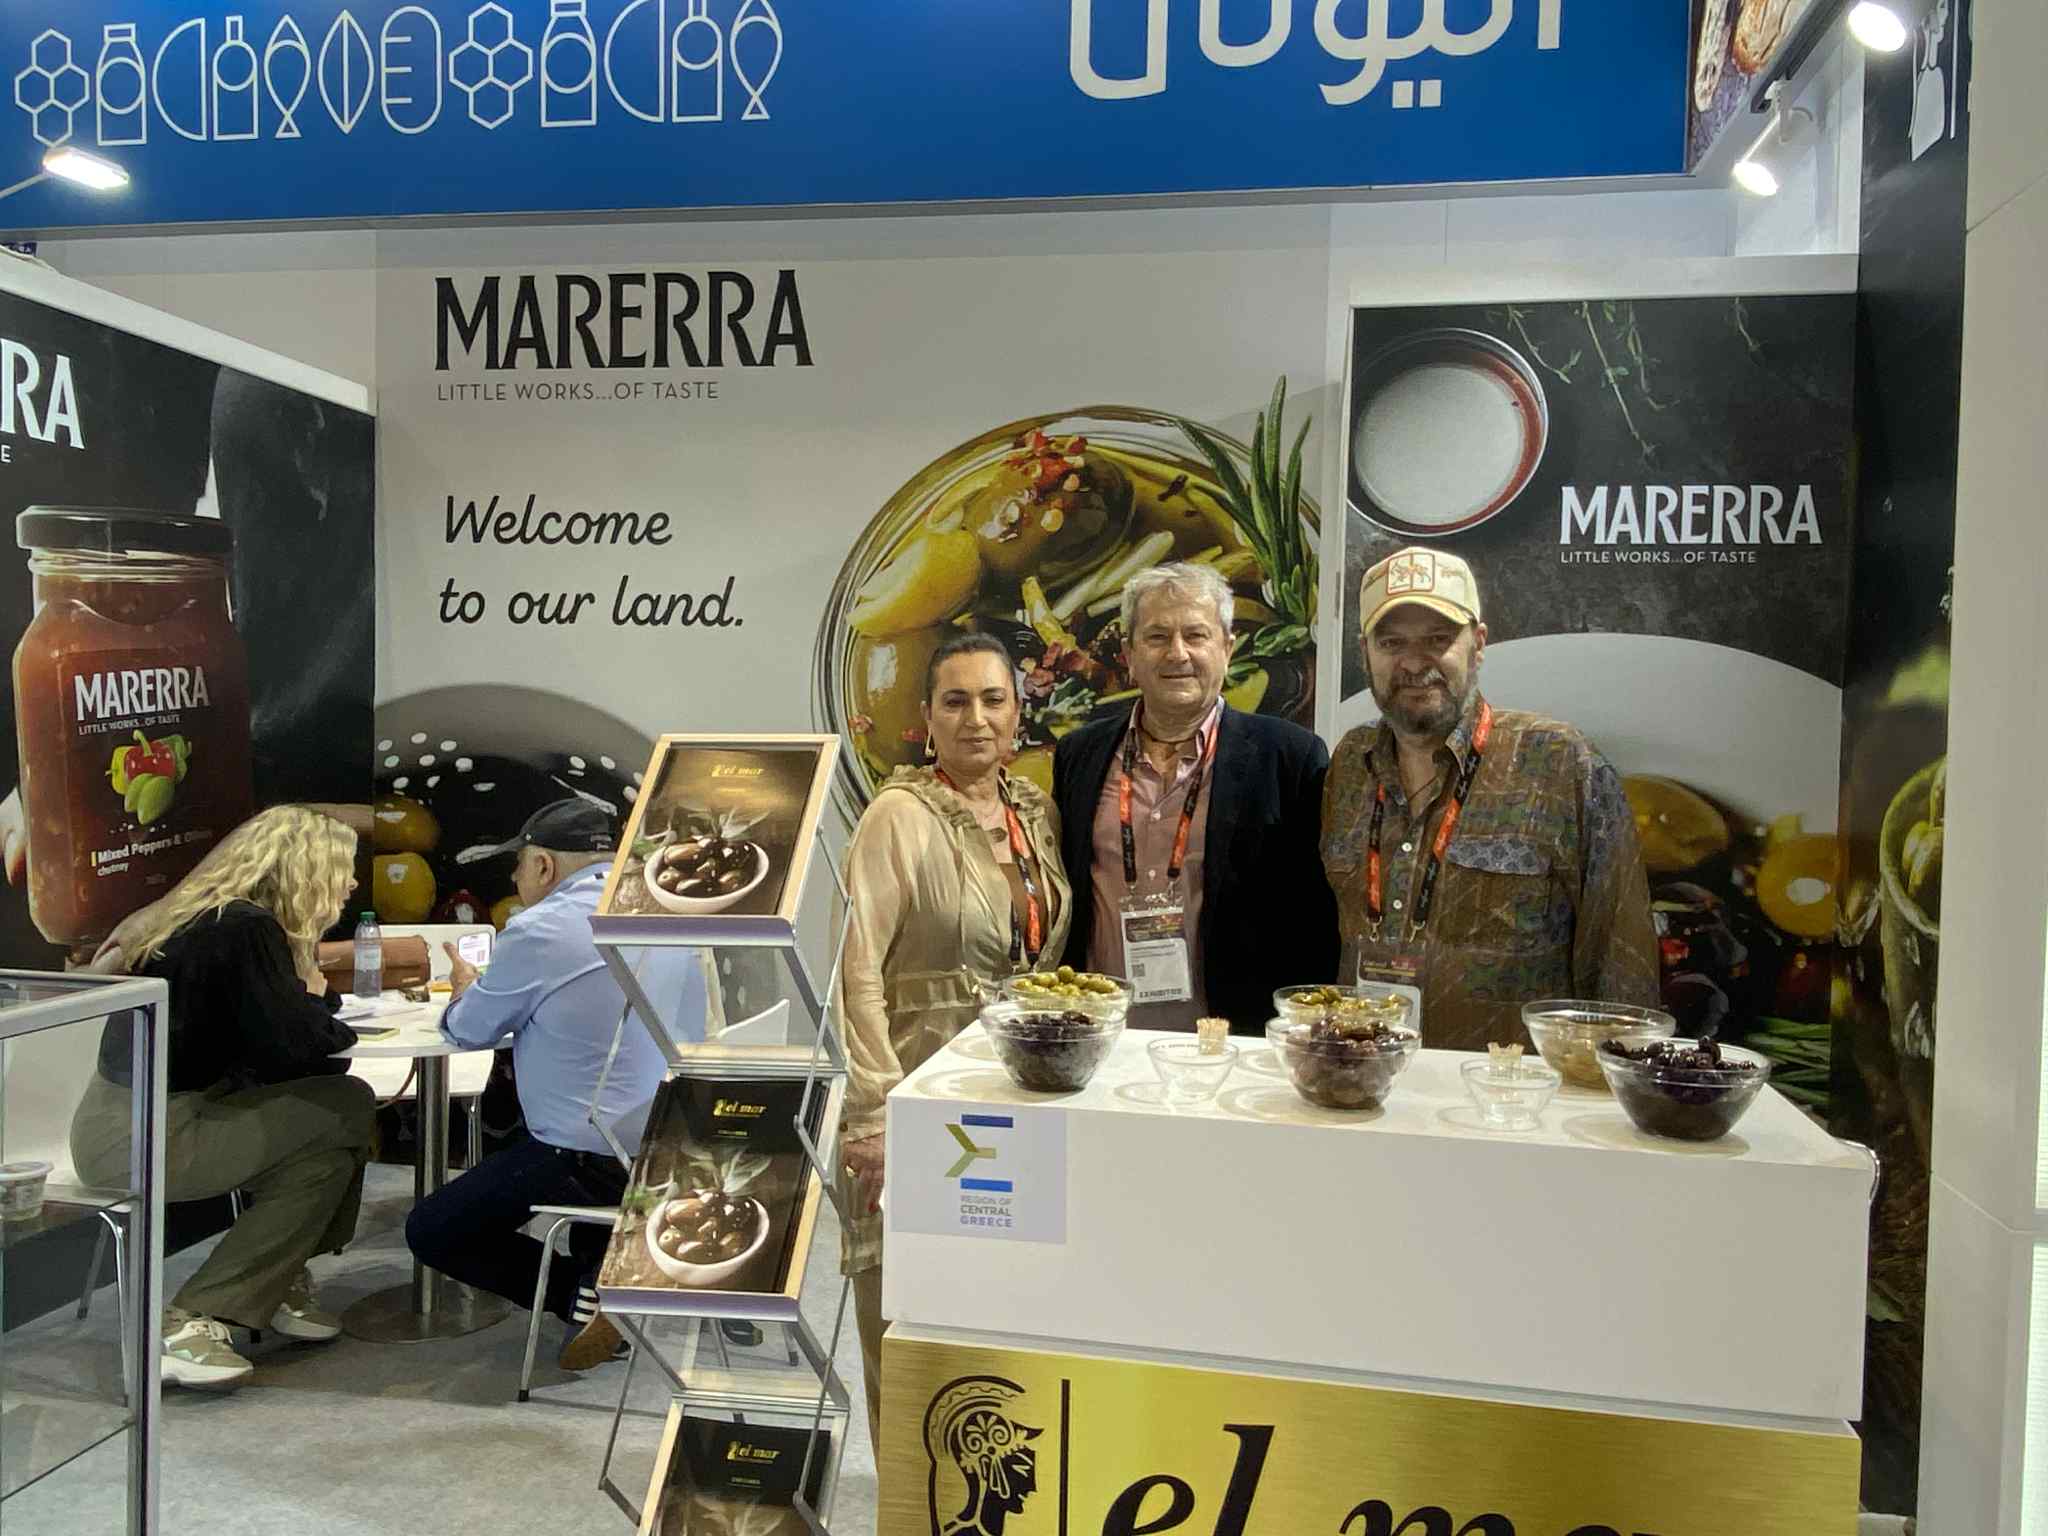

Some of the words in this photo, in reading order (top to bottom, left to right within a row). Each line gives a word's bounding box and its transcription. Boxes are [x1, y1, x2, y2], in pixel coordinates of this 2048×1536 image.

[435, 270, 814, 370] MARERRA
[437, 383, 507, 401] LITTLE
[652, 381, 720, 399] TASTE
[445, 493, 673, 546] Welcome
[1559, 484, 1824, 545] MARERRA
[1561, 552, 1609, 564] LITTLE
[1710, 551, 1756, 563] TASTE
[440, 577, 486, 624] to
[508, 591, 596, 624] our
[612, 574, 743, 627] land.
[74, 666, 210, 721] MARERRA
[79, 722, 108, 736] LITTLE
[158, 714, 181, 725] TASTE
[98, 845, 129, 863] Mixed
[131, 838, 172, 856] Peppers
[174, 834, 182, 845] &
[740, 1104, 766, 1113] mar
[960, 1204, 1011, 1216] CENTRAL
[960, 1216, 1012, 1227] GREECE
